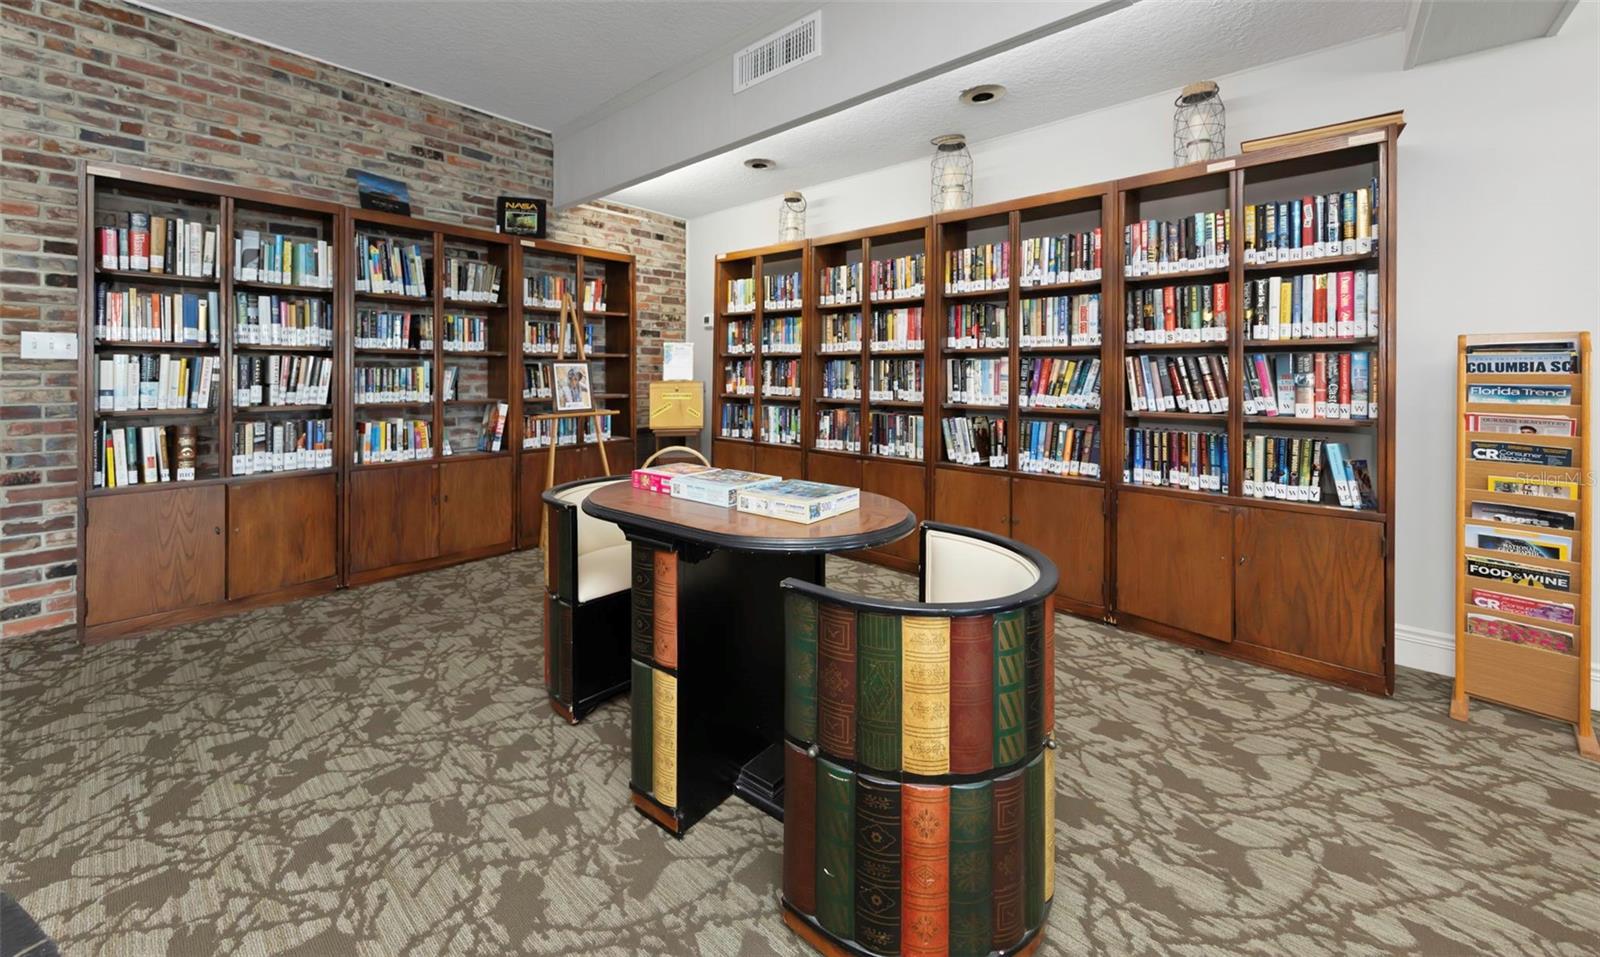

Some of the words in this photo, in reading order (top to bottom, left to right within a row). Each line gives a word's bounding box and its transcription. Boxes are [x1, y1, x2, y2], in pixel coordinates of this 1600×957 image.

[505, 202, 537, 210] NASA
[1468, 361, 1546, 373] COLUMBIA
[1470, 386, 1520, 396] Florida
[1522, 388, 1567, 397] Trend
[1473, 448, 1500, 460] CR
[1502, 543, 1537, 553] NATIONAL
[1474, 596, 1500, 610] CR
